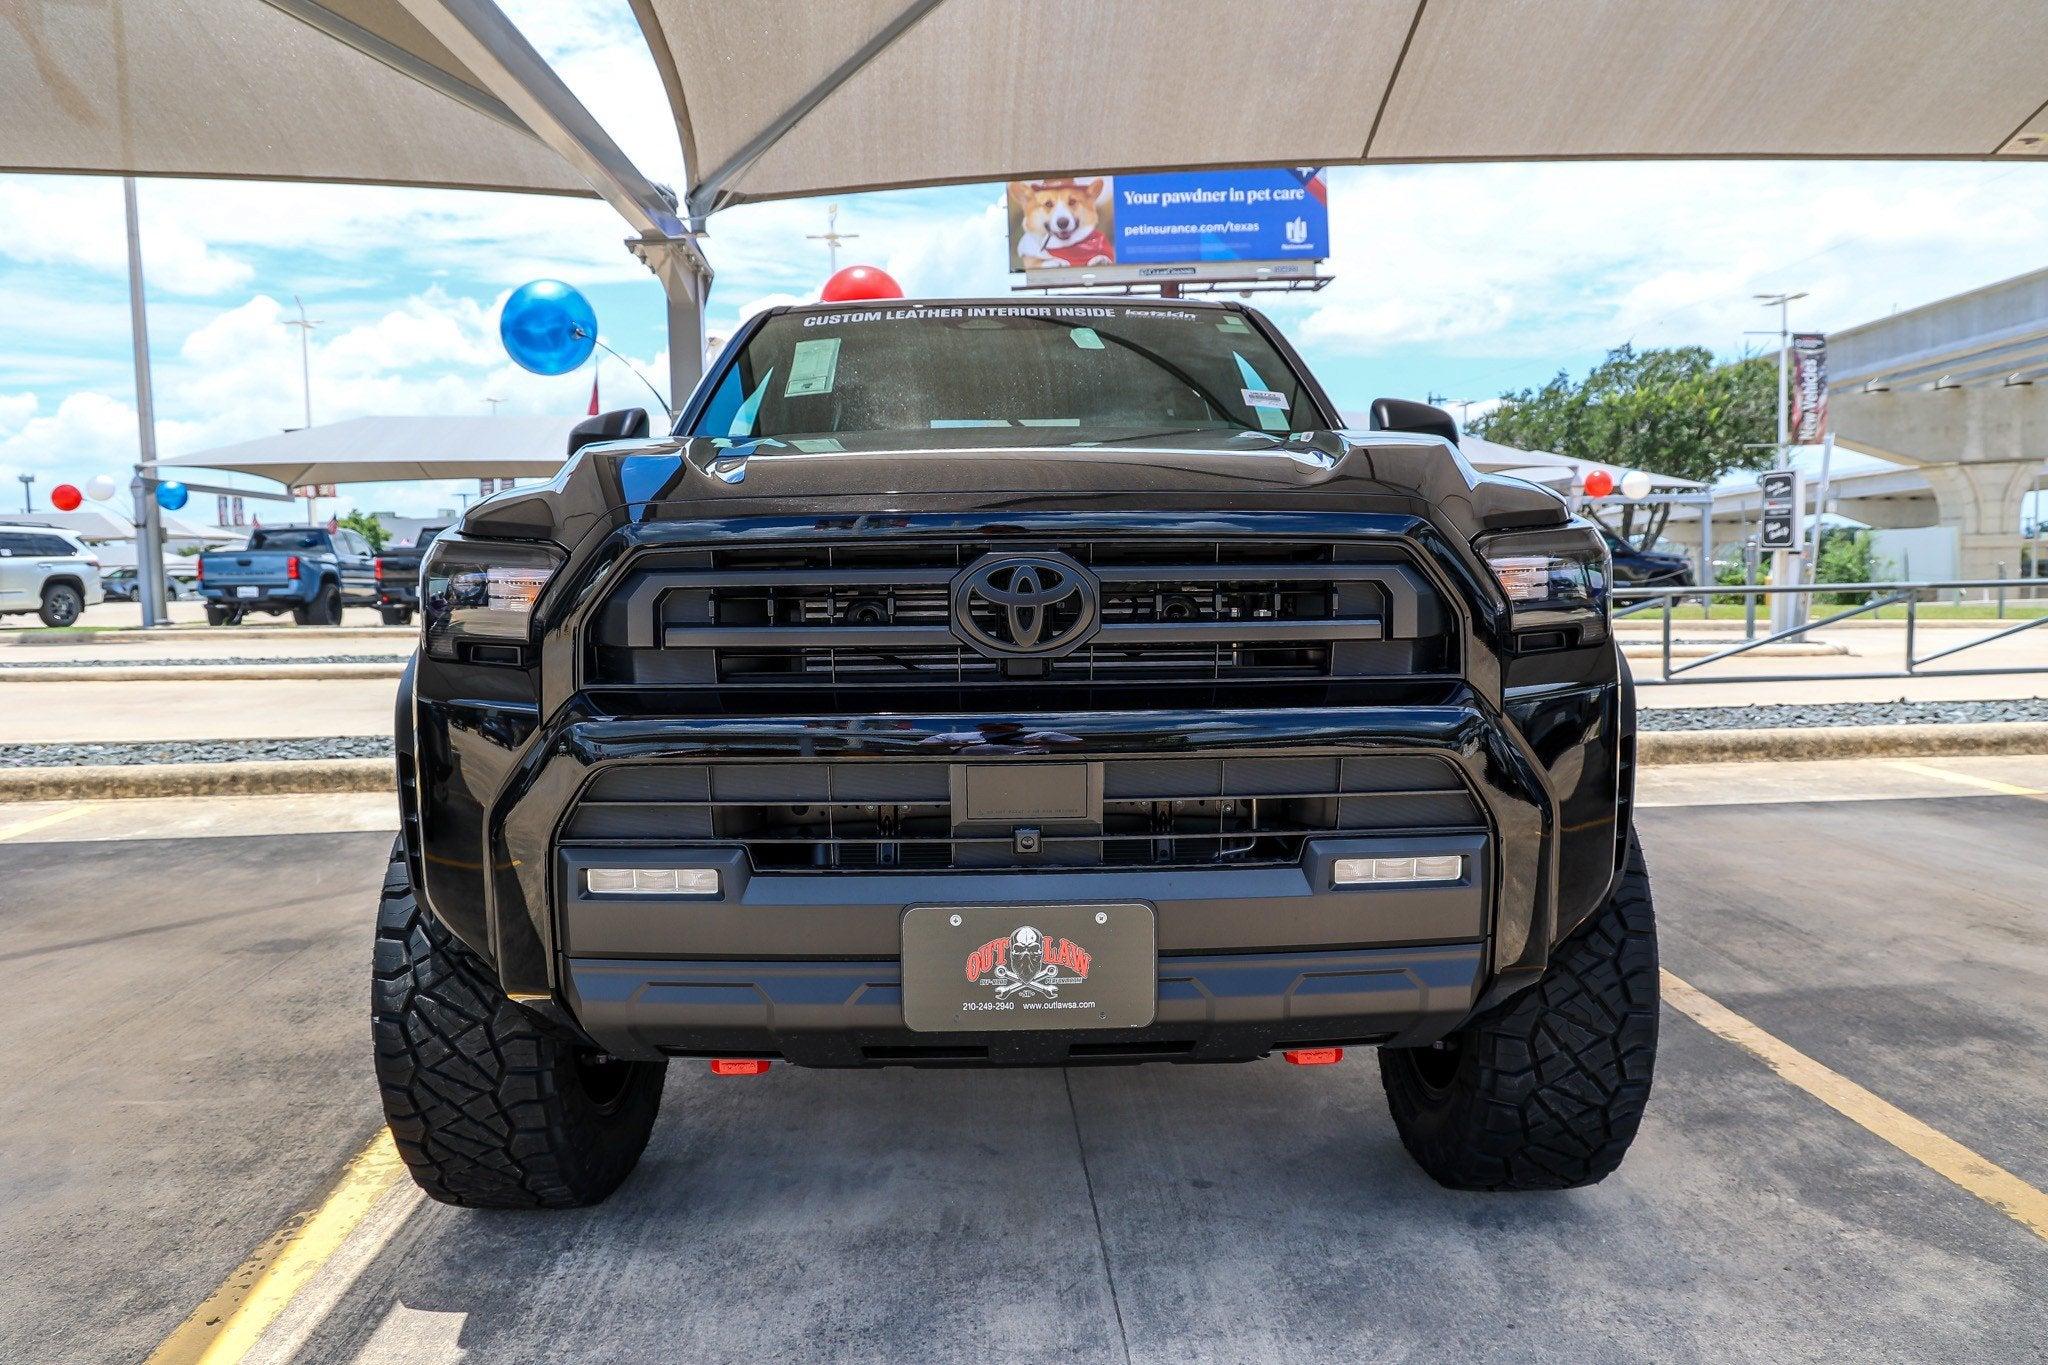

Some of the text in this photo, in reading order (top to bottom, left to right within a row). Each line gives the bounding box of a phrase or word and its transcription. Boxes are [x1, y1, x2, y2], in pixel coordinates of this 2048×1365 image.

[1123, 187, 1305, 207] Your pawdner in pet care
[1124, 221, 1260, 236] petinsurance.com/texas
[803, 311, 882, 327] CUSTOM
[885, 308, 963, 320] LEATHER
[967, 307, 1052, 317] INTERIOR
[1055, 307, 1116, 318] INSIDE
[1799, 358, 1819, 411] Vehicles
[1797, 412, 1818, 441] New
[966, 935, 1091, 982] OUT LAW
[962, 1000, 1096, 1011] 210-249-2940 www.outlawsa.com
